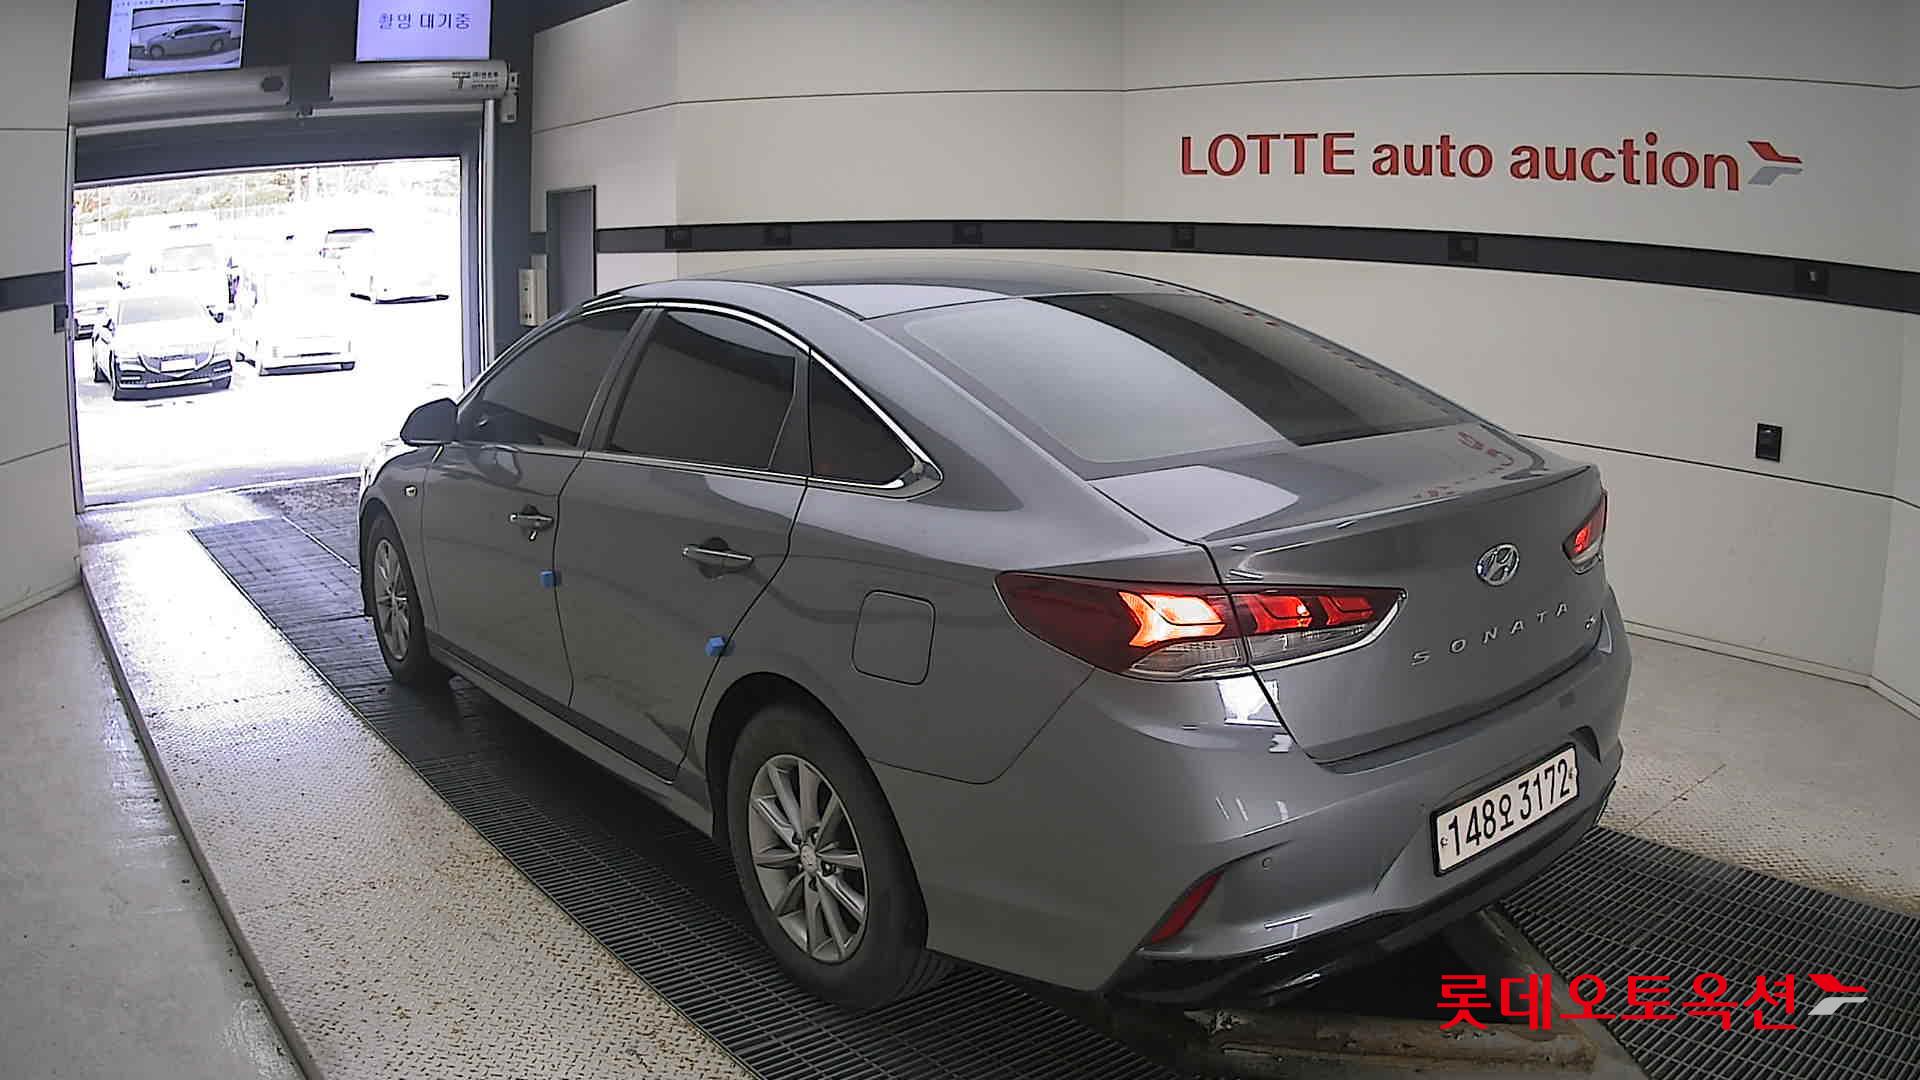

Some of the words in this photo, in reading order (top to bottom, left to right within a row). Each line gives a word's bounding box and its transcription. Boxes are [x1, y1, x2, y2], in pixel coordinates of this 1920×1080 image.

[419, 12, 472, 30] 대기중
[1180, 132, 1355, 176] LOTTE
[1371, 134, 1493, 178] auto
[1509, 131, 1739, 190] auction
[1411, 601, 1569, 666] SONATA
[1518, 758, 1570, 820] 3172
